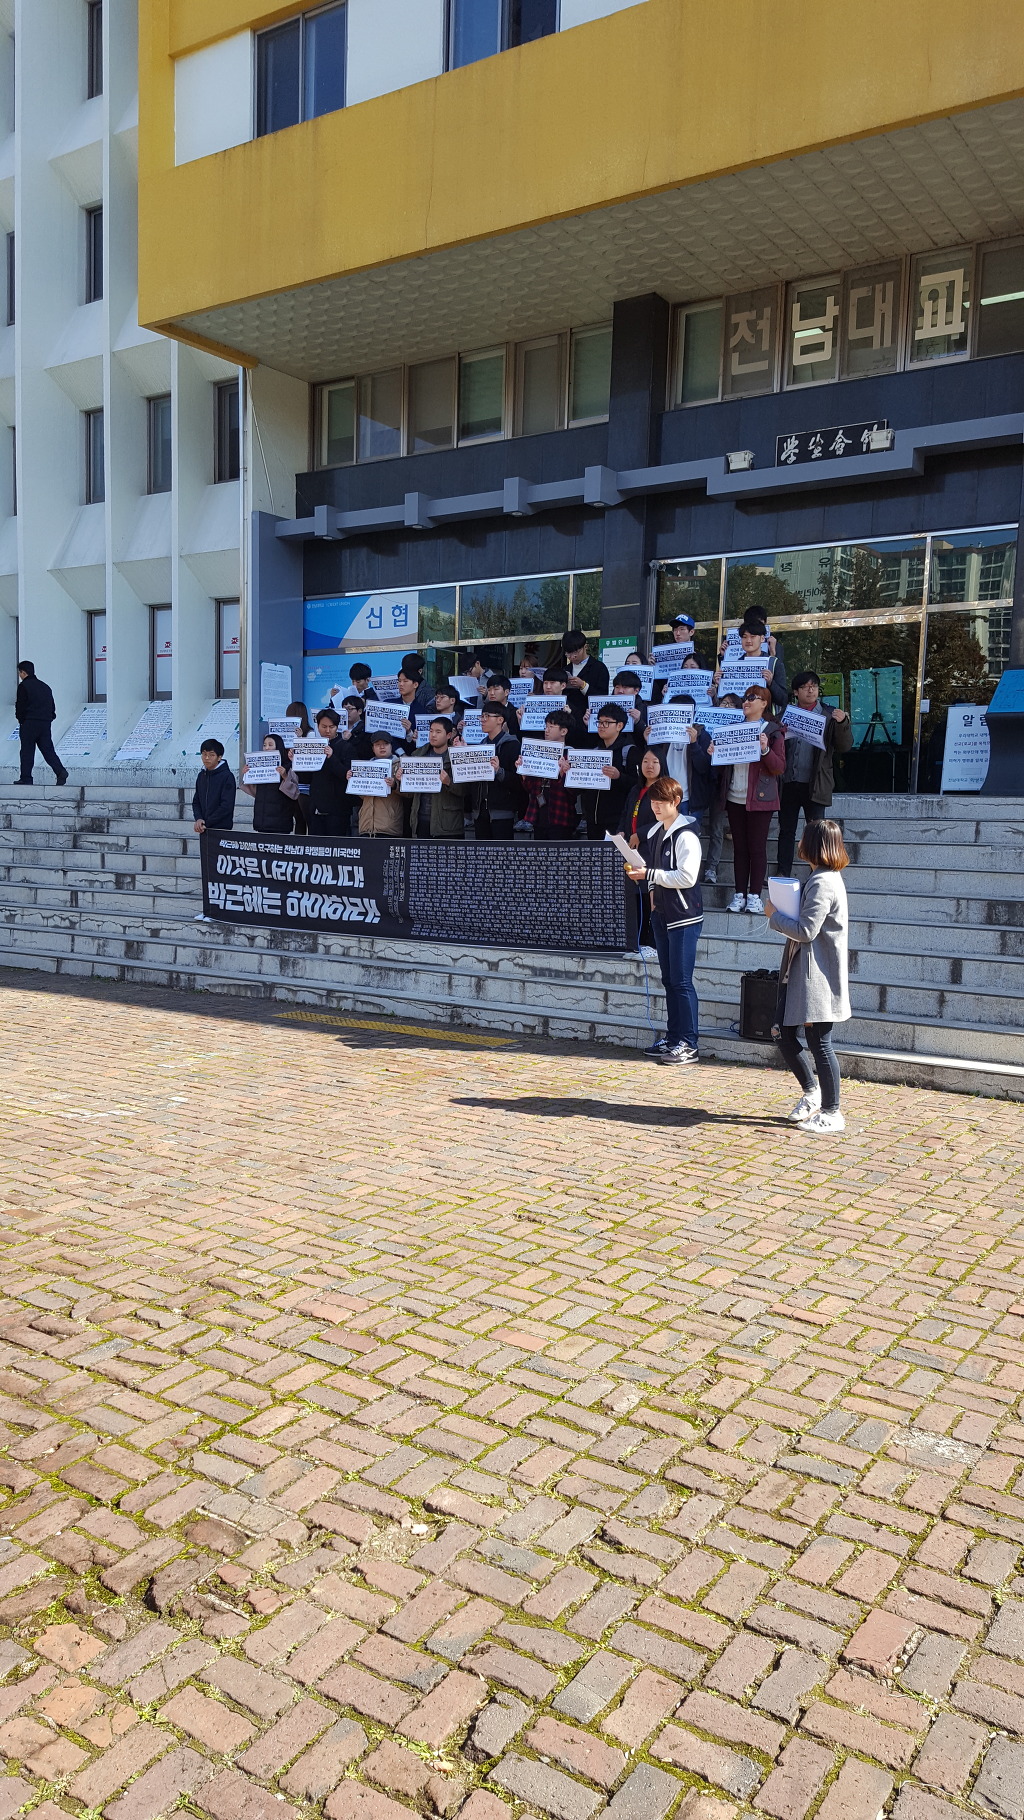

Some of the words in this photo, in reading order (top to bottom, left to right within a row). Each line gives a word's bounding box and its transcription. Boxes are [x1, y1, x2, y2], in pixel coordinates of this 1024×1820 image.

[366, 604, 408, 629] 신협
[258, 843, 283, 854] 요구하는
[284, 845, 304, 856] 전남대
[305, 847, 332, 857] 학생들의
[332, 848, 361, 858] 시국선언
[217, 855, 261, 878] 이것은
[262, 859, 310, 883] 나라가
[208, 881, 281, 915] 박근혜는
